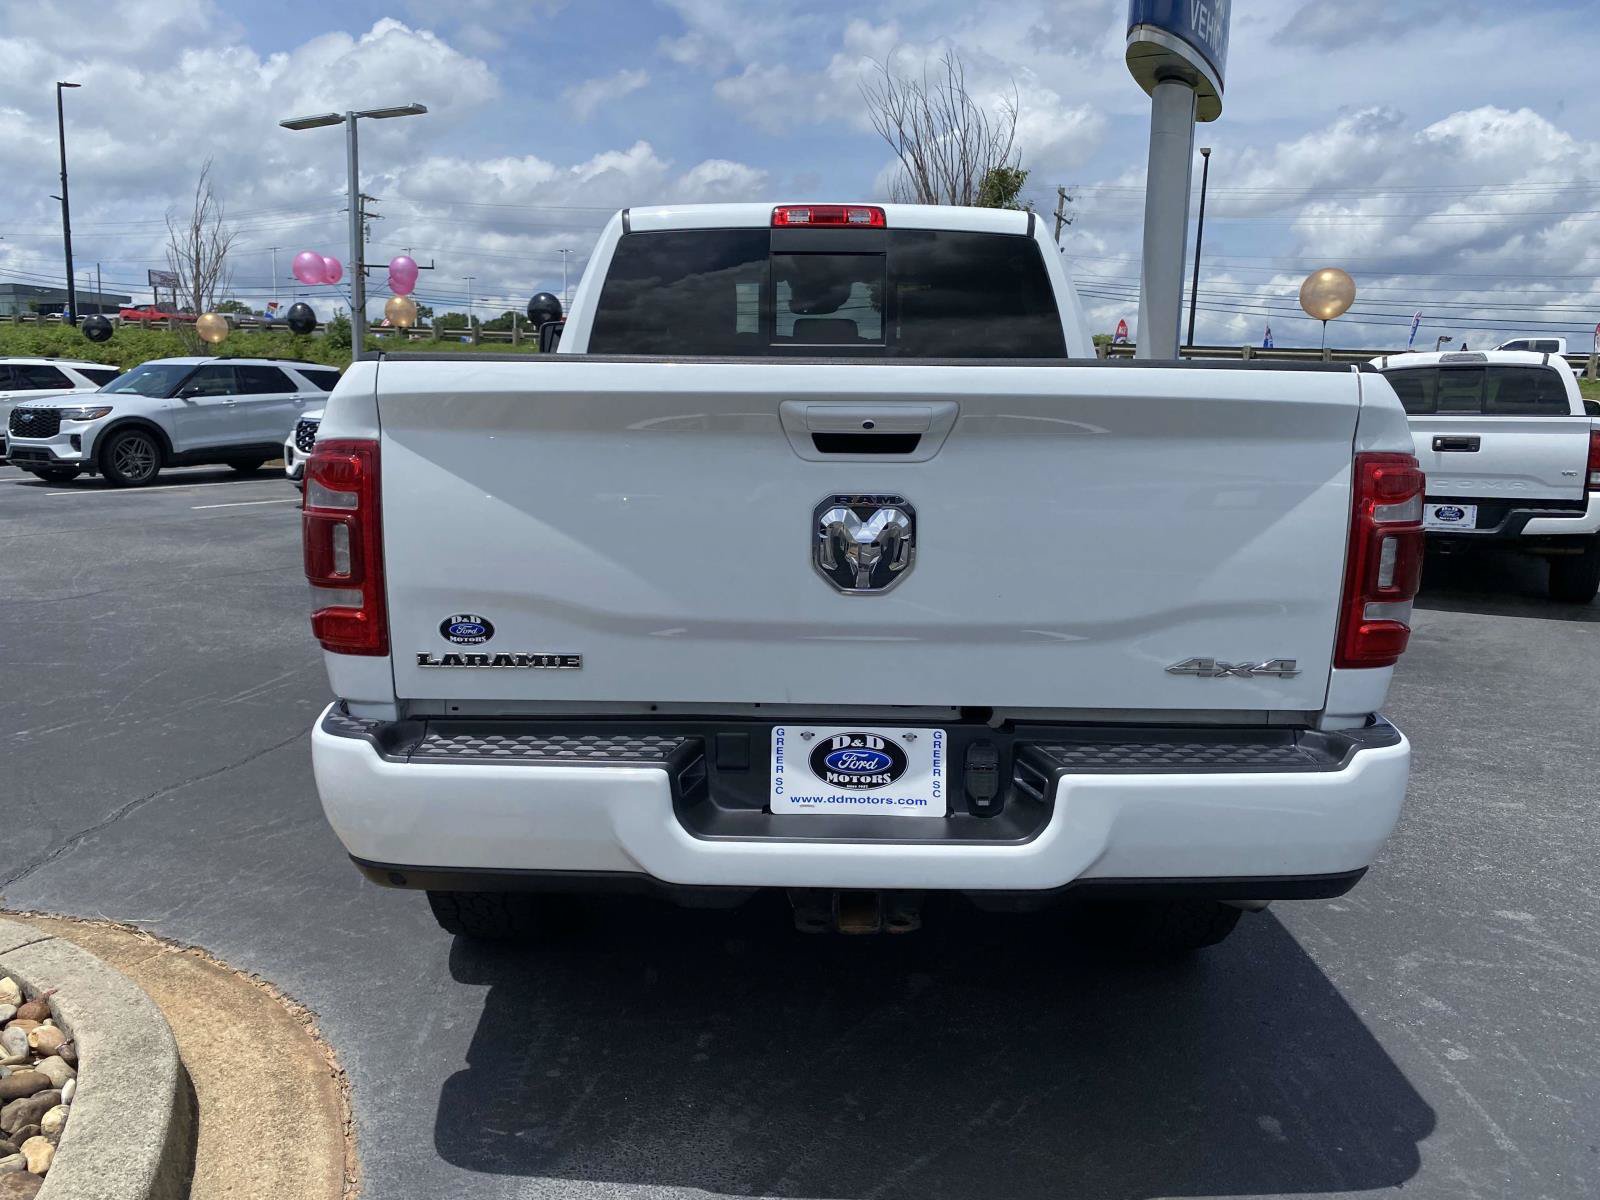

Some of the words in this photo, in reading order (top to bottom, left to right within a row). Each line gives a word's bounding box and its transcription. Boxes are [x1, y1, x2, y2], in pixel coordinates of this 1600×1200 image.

[451, 616, 482, 624] D&D
[456, 625, 478, 634] Ford
[416, 652, 582, 668] LARAMIE
[776, 728, 785, 773] GREER
[831, 735, 885, 751] D&D
[837, 752, 879, 771] Ford
[933, 731, 942, 776] GREER
[775, 777, 784, 794] SC
[826, 771, 892, 784] MOTORS
[932, 781, 941, 798] SC
[790, 795, 928, 806] www.ddmotors.com
